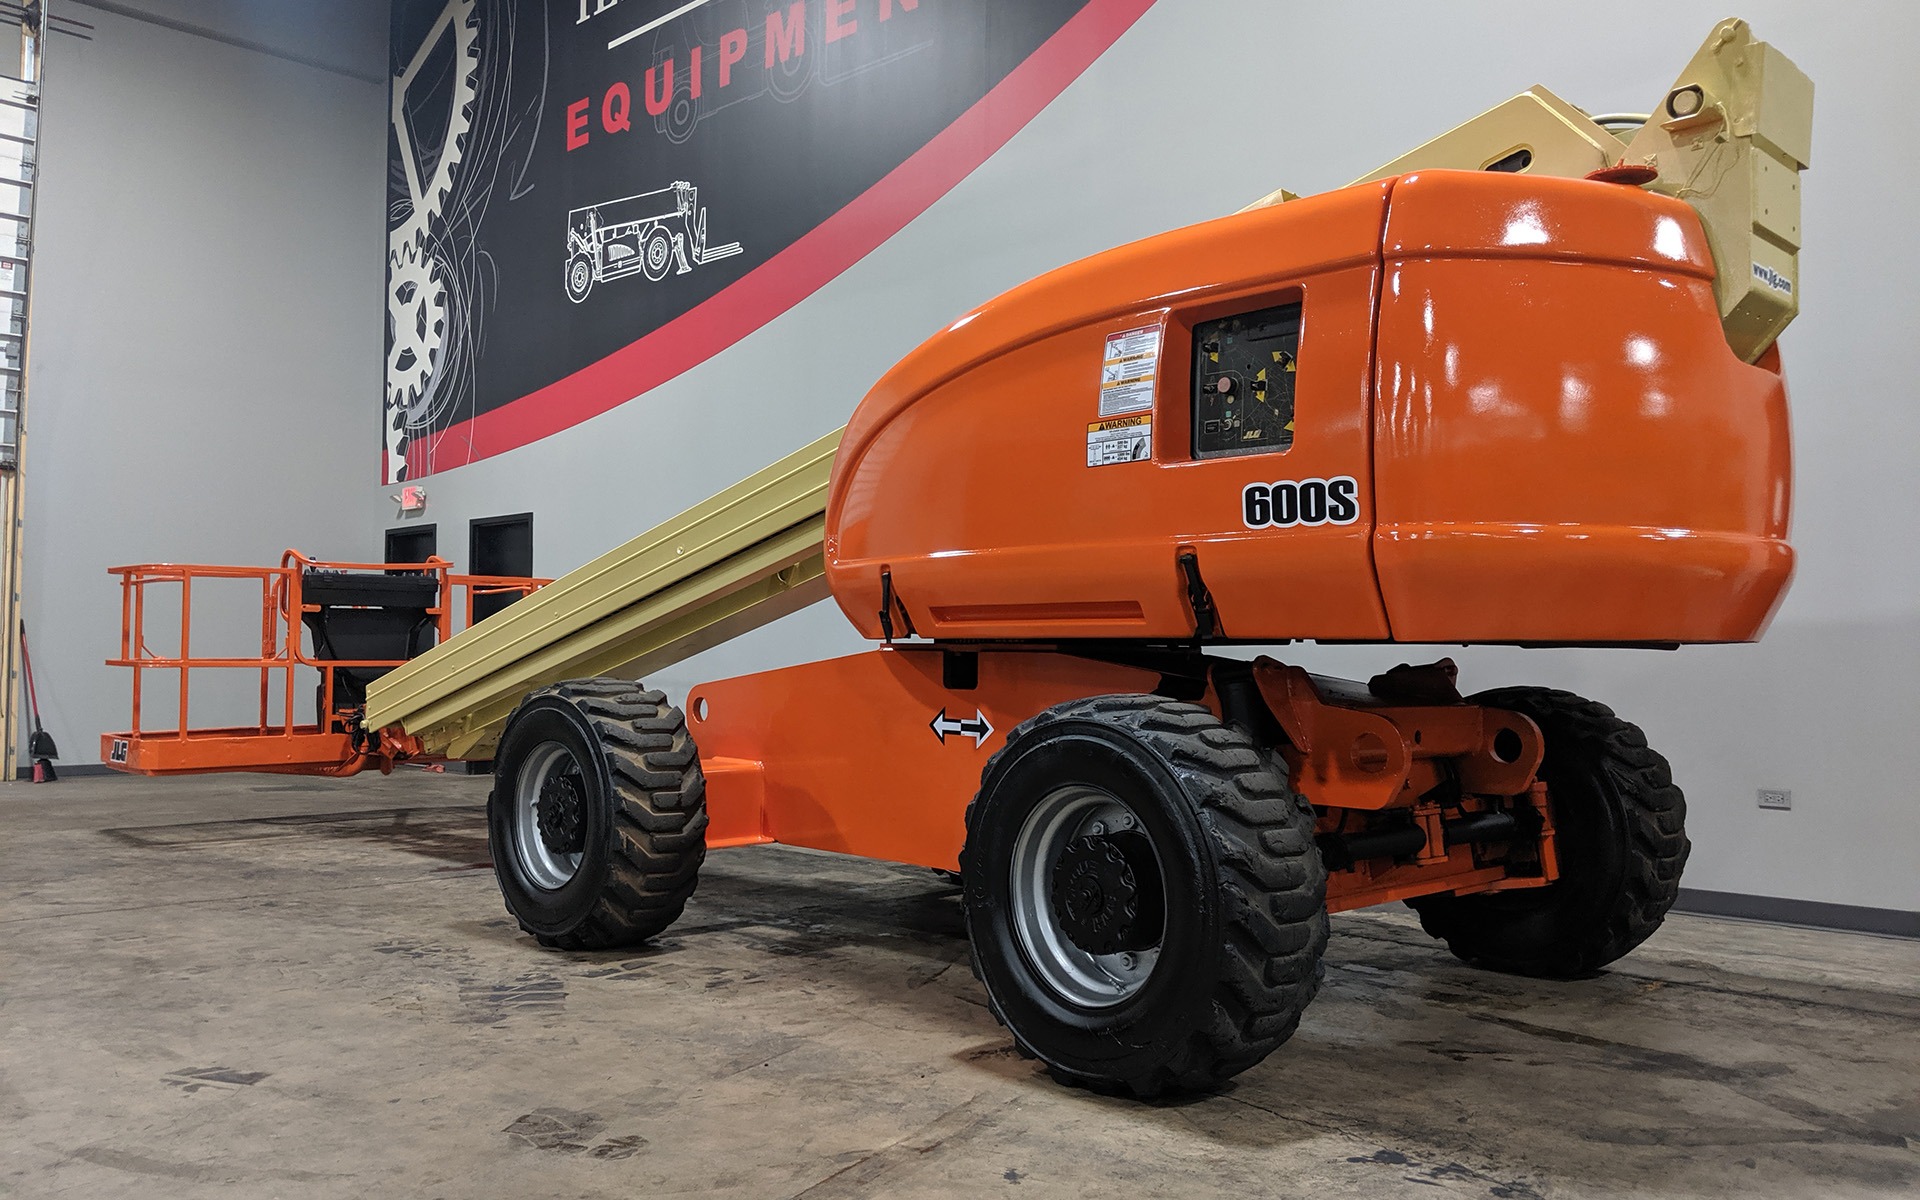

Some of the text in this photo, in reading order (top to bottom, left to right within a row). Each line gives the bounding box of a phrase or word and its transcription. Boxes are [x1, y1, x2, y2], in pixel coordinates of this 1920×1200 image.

[1752, 262, 1792, 293] www.jlg.com
[1121, 377, 1141, 385] WARNING
[1105, 416, 1142, 430] WARNING
[1243, 477, 1360, 528] 600S
[111, 741, 128, 762] JLG
